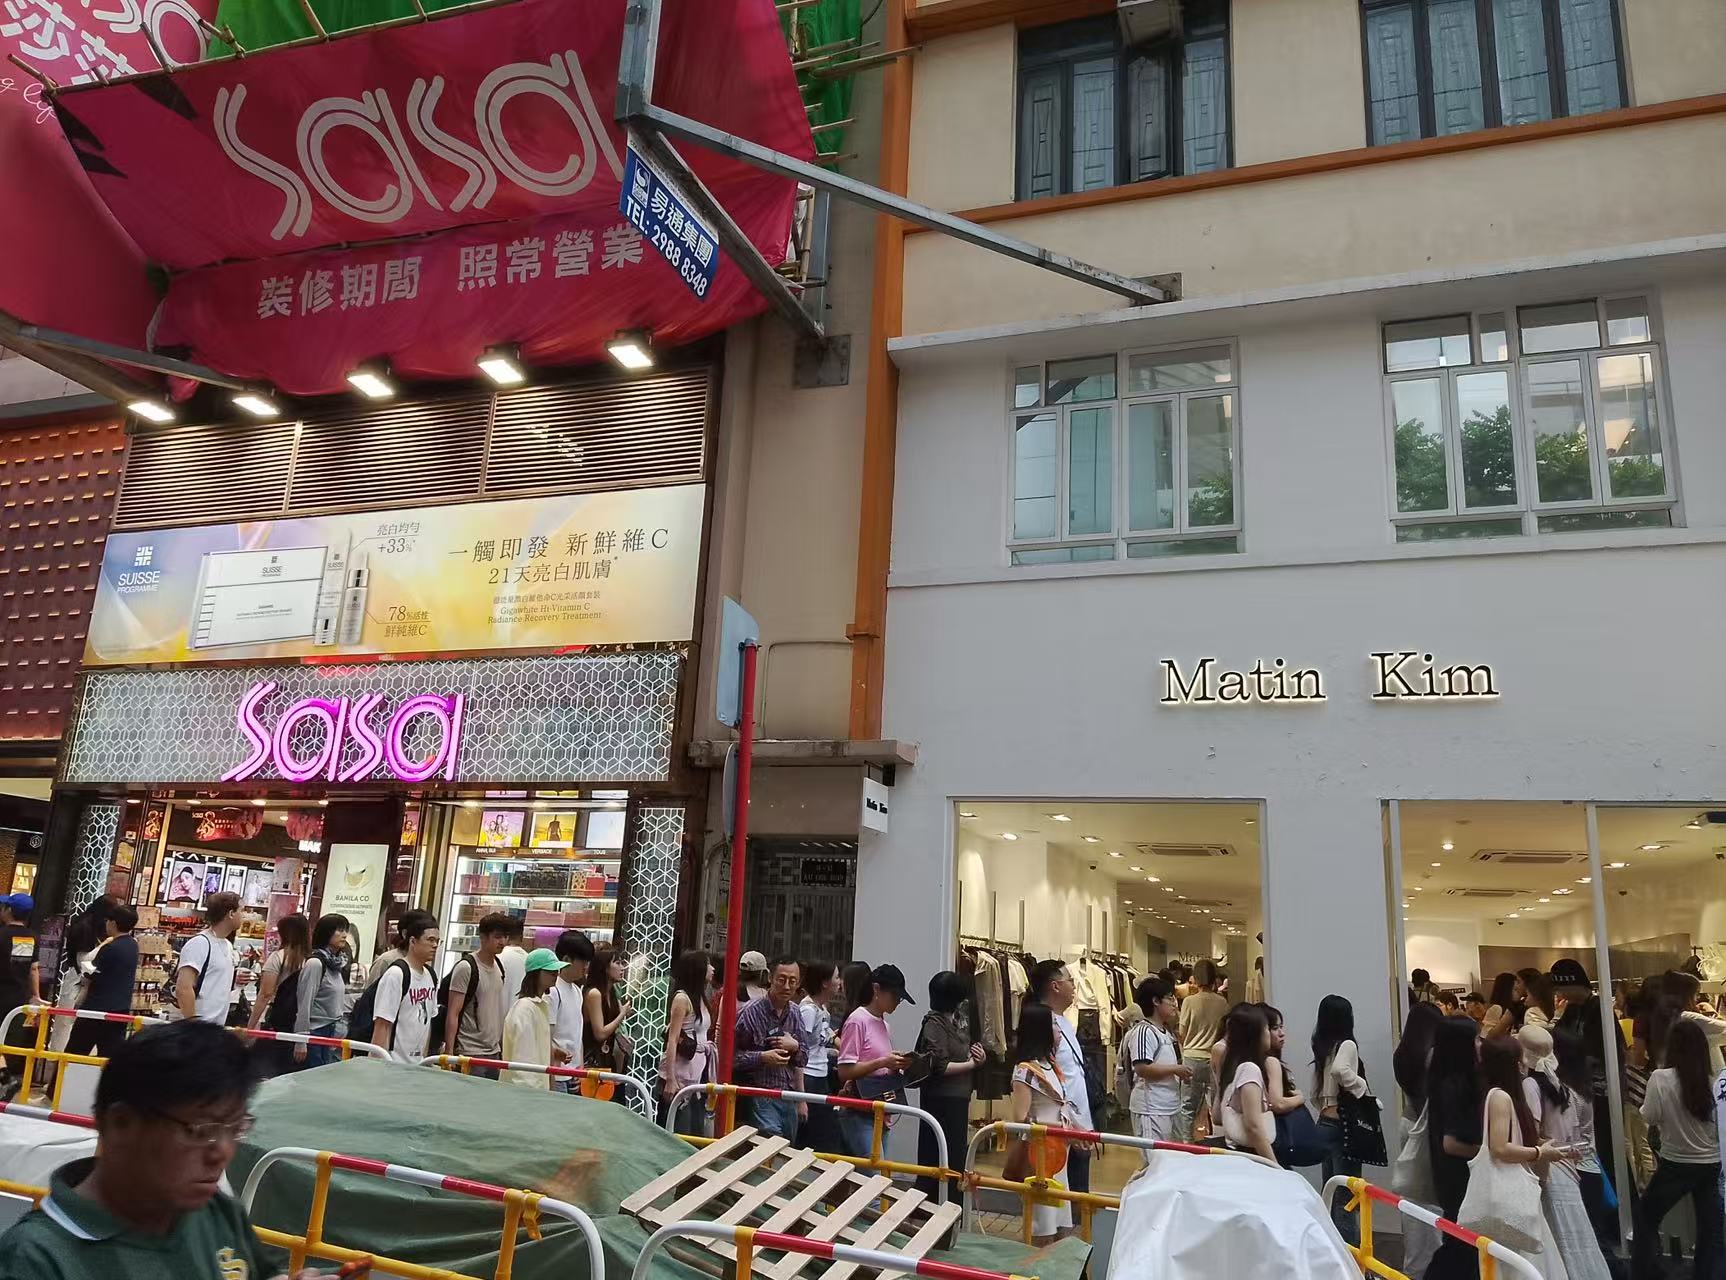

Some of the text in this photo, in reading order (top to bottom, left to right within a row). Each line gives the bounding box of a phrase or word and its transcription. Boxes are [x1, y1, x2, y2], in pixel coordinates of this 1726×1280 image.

[650, 187, 714, 268] 易通集團
[626, 195, 650, 235] TEL:
[651, 224, 681, 267] 2988
[681, 257, 708, 297] 8348
[256, 223, 644, 320] 裝修期間 照常營業
[377, 522, 420, 536] 亮白均勻
[448, 528, 669, 563] 一觸即發 新鮮維C
[116, 585, 159, 594] PROGRAMME
[118, 570, 161, 586] SUISSE
[488, 612, 602, 624] Radiance Recovery Treatment
[500, 605, 538, 615] Gigawhite
[584, 602, 591, 610] C
[1160, 651, 1500, 702] Matin Kim
[220, 681, 464, 783] sasa
[171, 850, 227, 863] KATE
